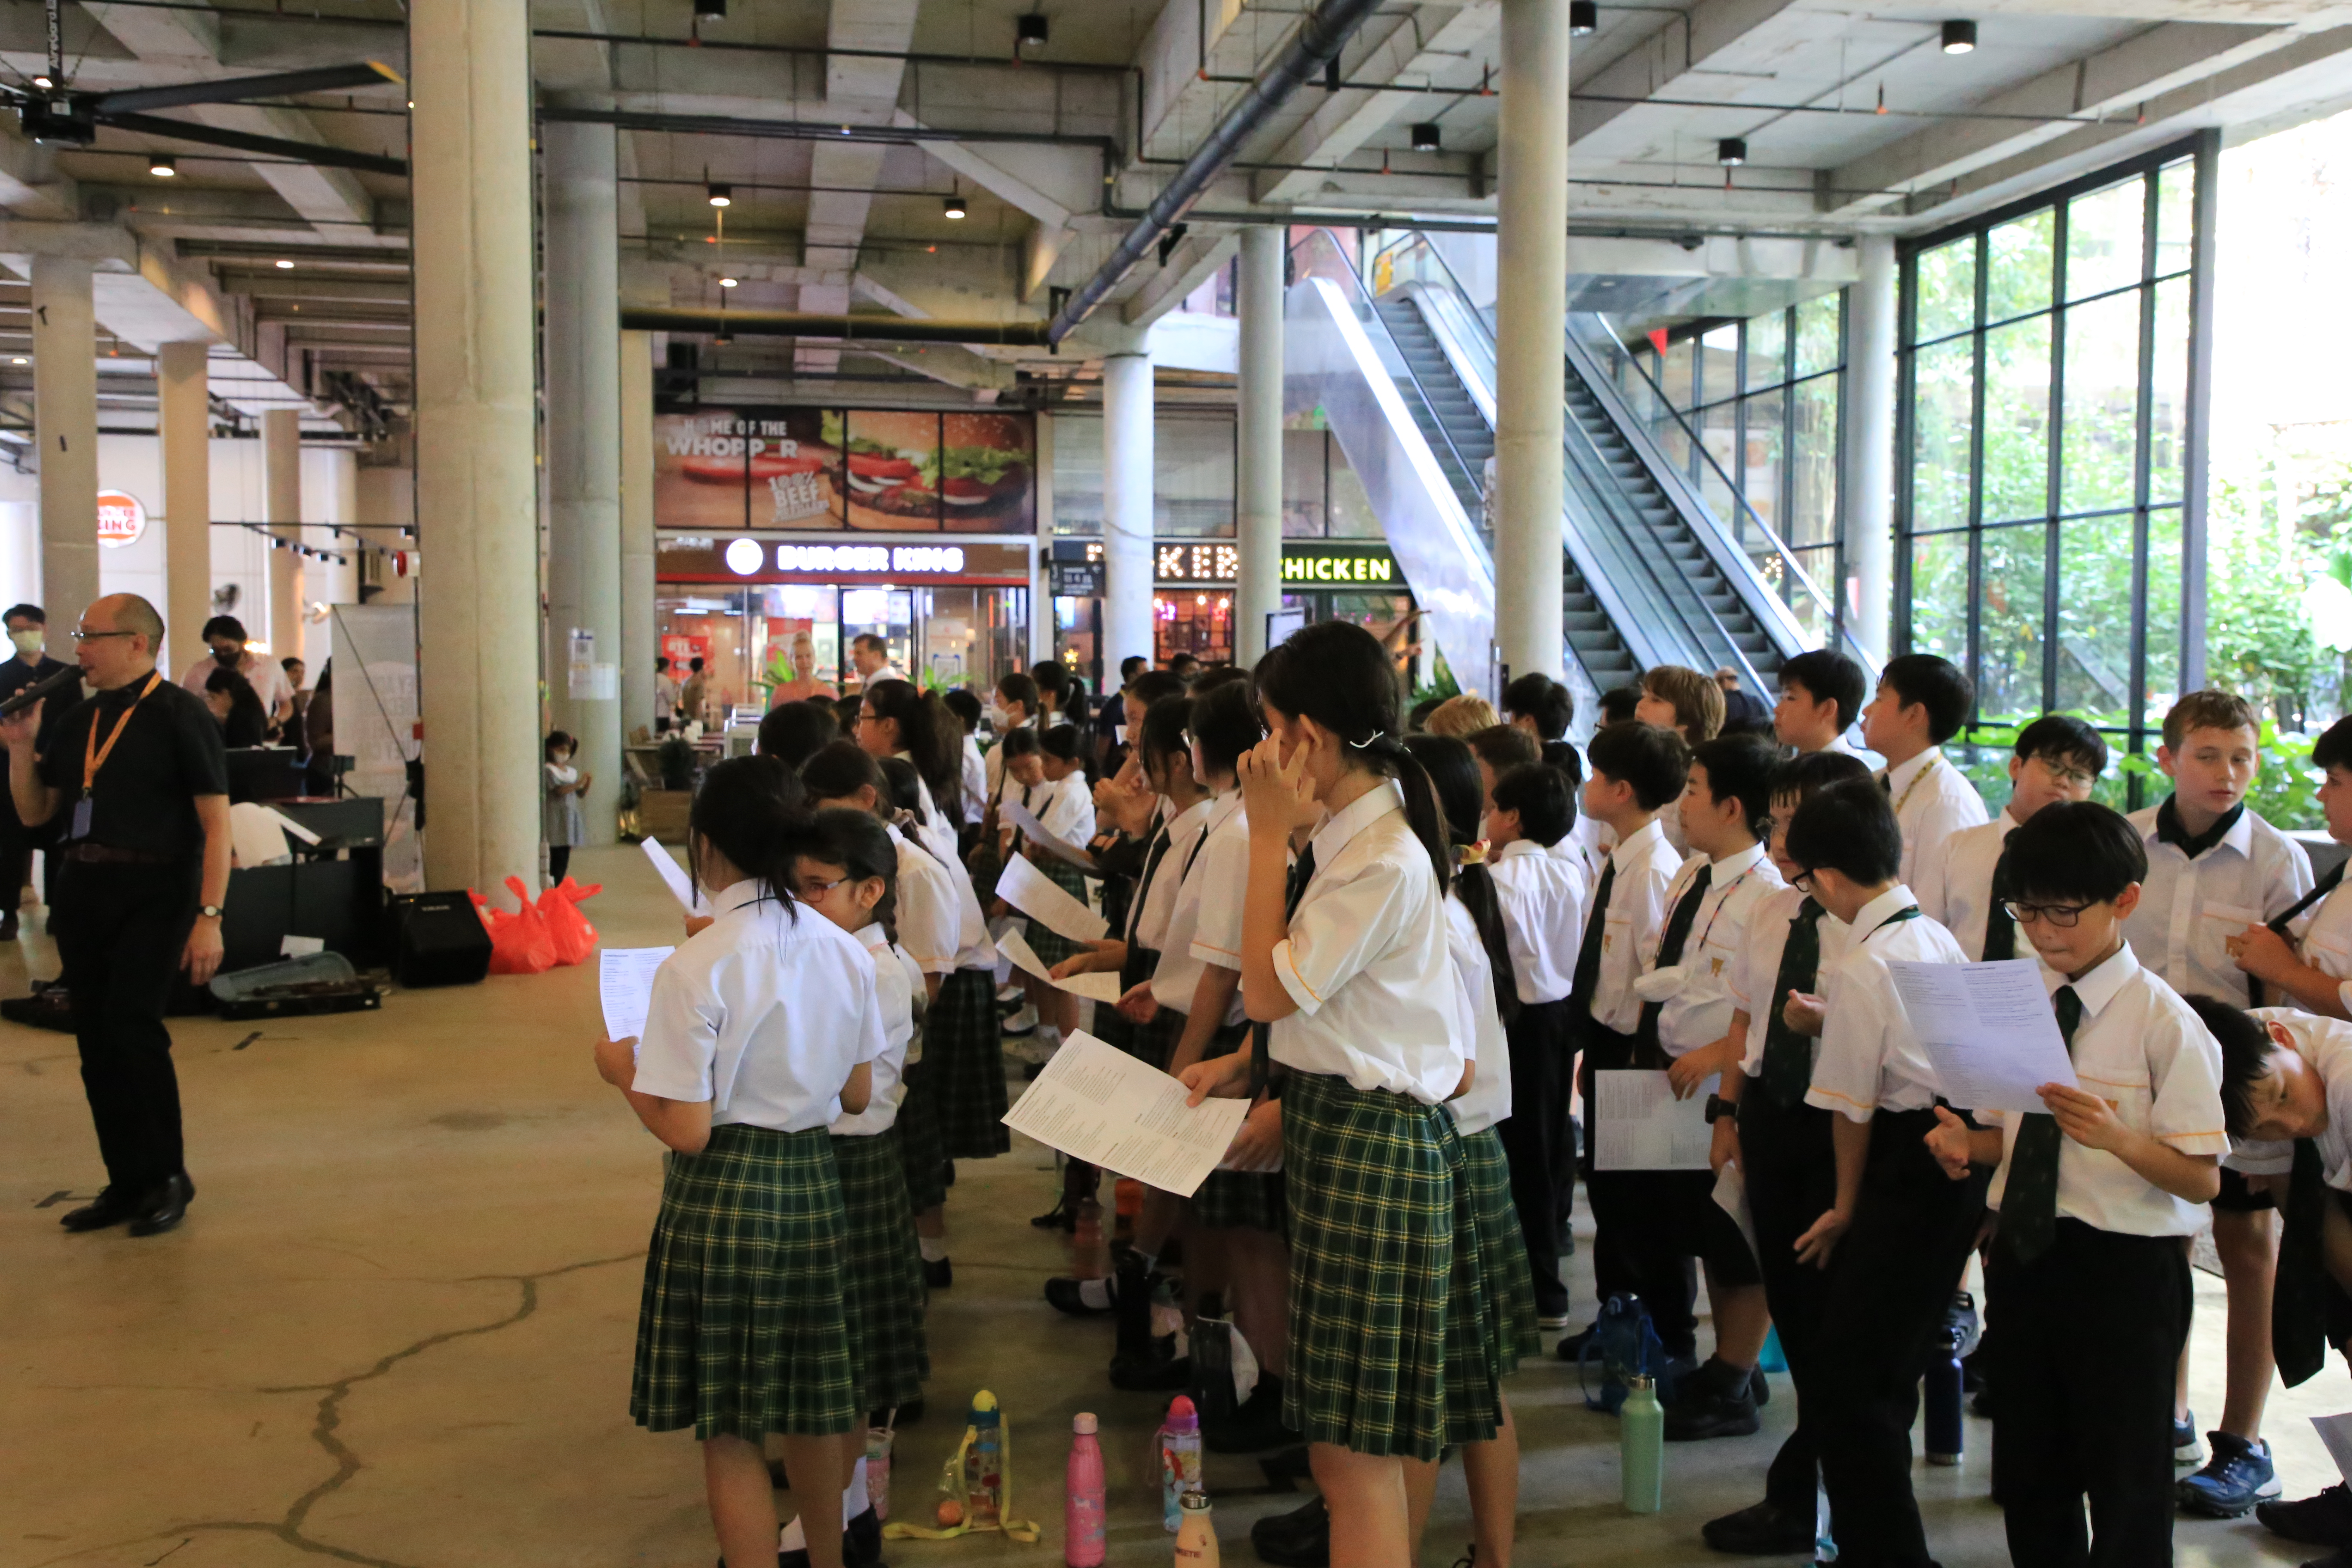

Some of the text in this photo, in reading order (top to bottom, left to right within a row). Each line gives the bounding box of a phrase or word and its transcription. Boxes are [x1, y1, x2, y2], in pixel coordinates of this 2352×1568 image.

[736, 420, 756, 435] OF
[760, 420, 787, 436] THE
[774, 482, 819, 507] BEEF
[778, 545, 964, 573] BURGER KING
